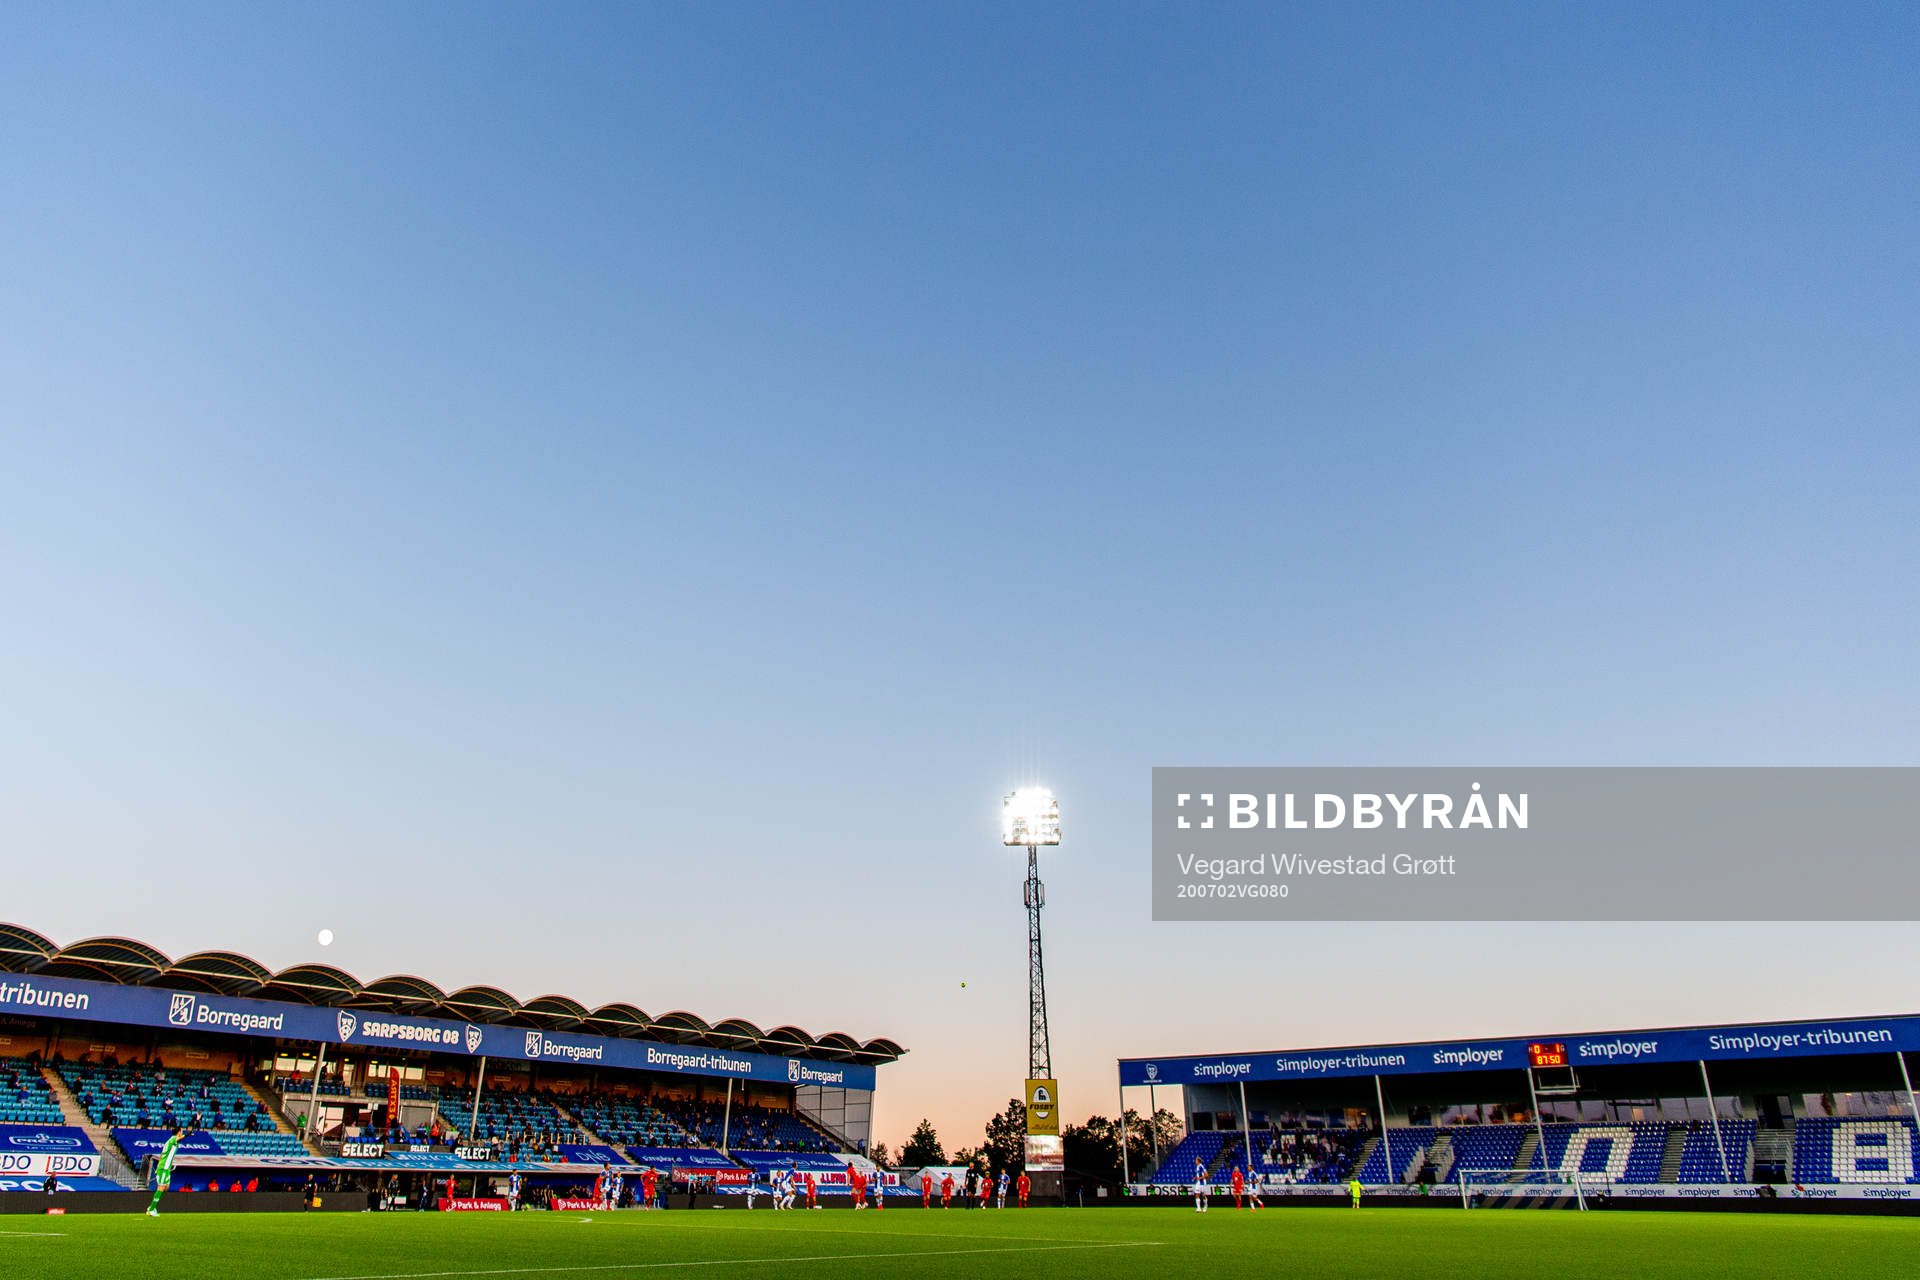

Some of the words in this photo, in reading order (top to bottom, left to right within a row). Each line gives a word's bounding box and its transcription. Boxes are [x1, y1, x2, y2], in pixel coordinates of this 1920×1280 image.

[0, 982, 90, 1010] tribunen
[196, 1004, 284, 1032] Borregaard
[362, 1021, 441, 1043] SARPSBORG
[442, 1029, 460, 1045] 08
[1709, 1029, 1894, 1053] Simployer-tribunen
[543, 1040, 603, 1062] Borregaard
[647, 1047, 752, 1073] Borregaard-tribunen
[1276, 1053, 1406, 1074] Simployer-tribunen
[801, 1067, 843, 1083] Borregaard
[342, 1142, 384, 1157] SELECT
[410, 1145, 430, 1153] SELECT
[454, 1147, 491, 1160] SELECT
[52, 1156, 92, 1171] BDO
[457, 1201, 473, 1209] Park
